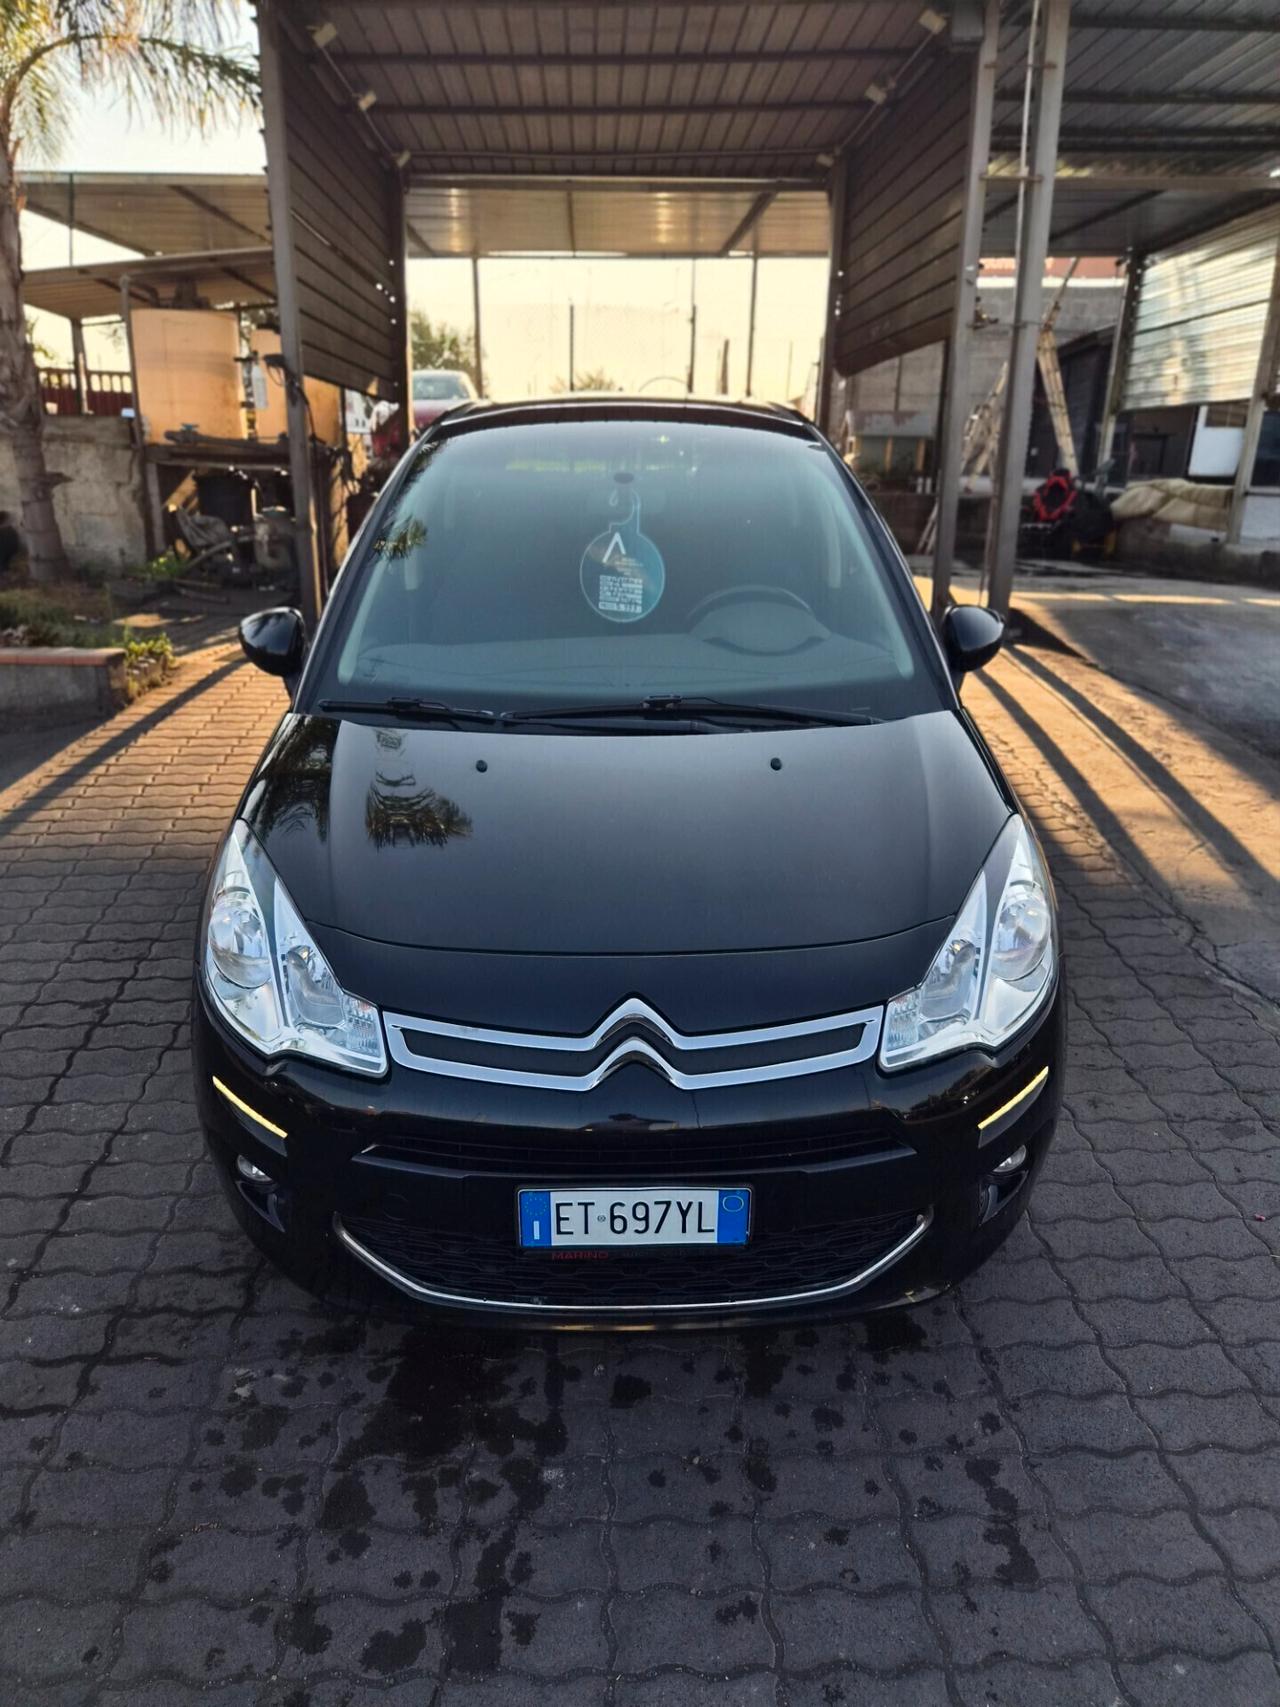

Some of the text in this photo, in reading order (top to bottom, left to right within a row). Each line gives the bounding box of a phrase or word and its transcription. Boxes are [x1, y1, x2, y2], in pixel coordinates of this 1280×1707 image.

[533, 1220, 540, 1240] I
[555, 1201, 715, 1235] ET 697YL
